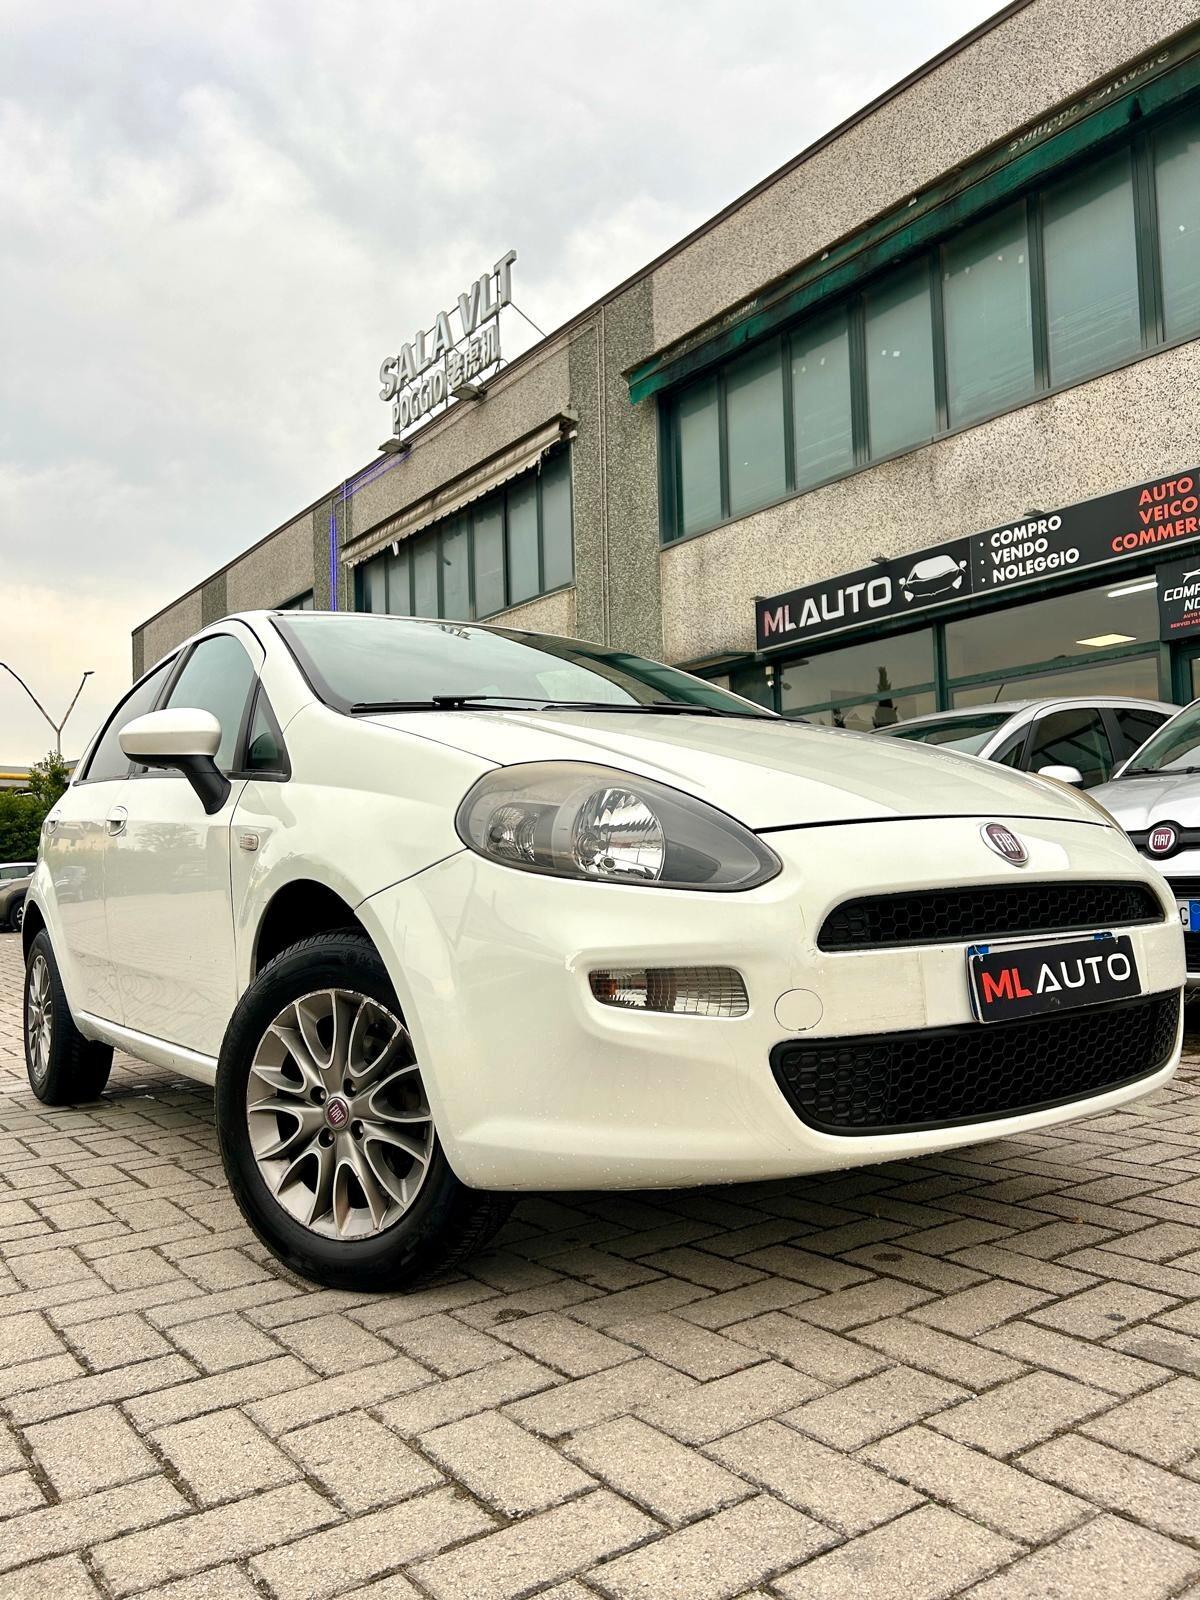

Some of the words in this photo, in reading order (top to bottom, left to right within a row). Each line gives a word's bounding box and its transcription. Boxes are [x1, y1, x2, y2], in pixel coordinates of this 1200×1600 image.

[379, 310, 454, 402] SALA
[457, 249, 518, 337] VLT
[392, 369, 448, 435] POGGIO
[1138, 476, 1194, 506] AUTO
[990, 515, 1062, 548] COMPRO
[1111, 516, 1200, 552] COMMER
[990, 538, 1049, 565] VENDO
[992, 548, 1080, 584] NOLEGGIO
[992, 833, 1020, 852] FIAT
[1153, 833, 1170, 846] FIAT
[329, 1103, 345, 1122] FIAT
